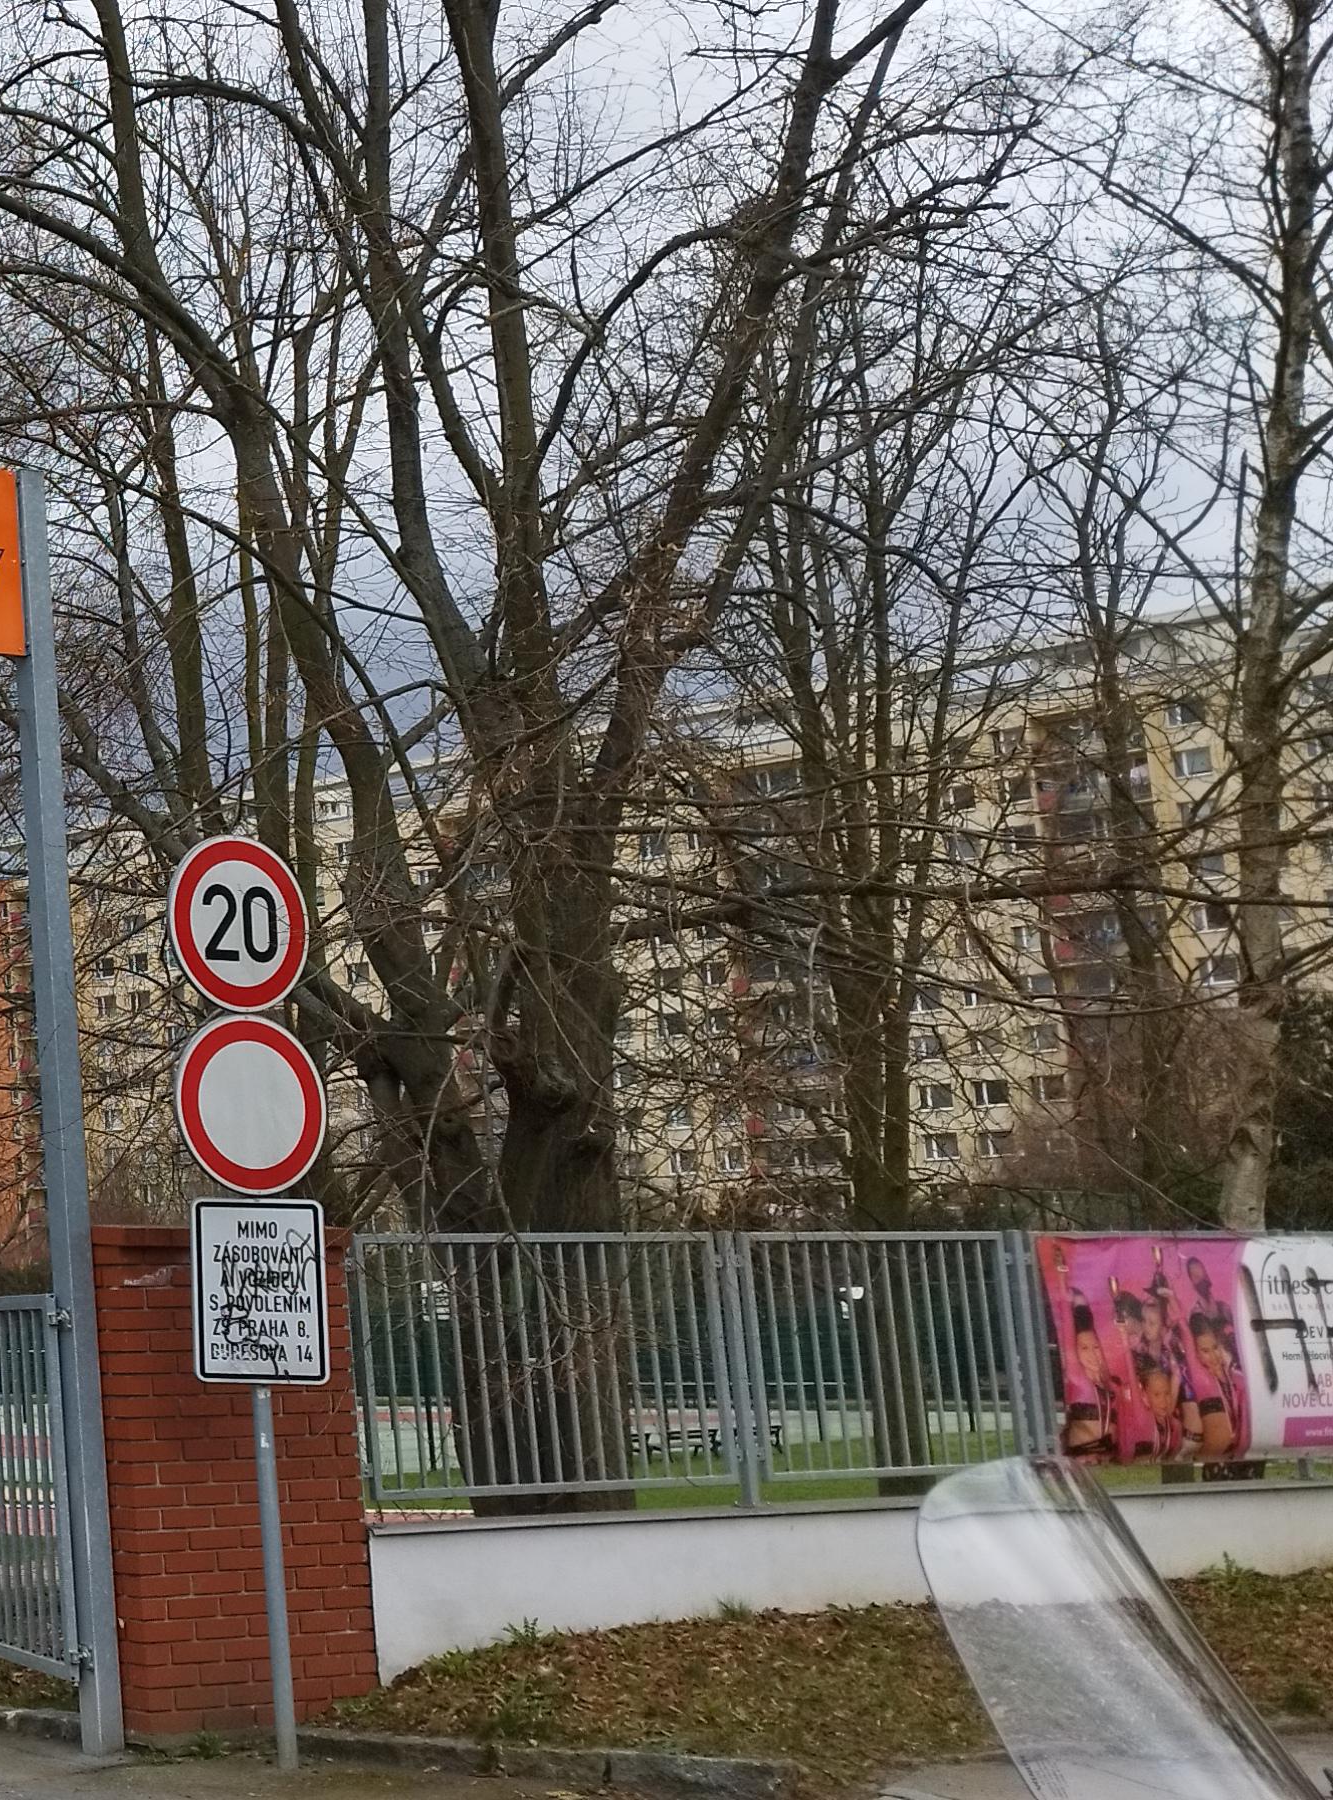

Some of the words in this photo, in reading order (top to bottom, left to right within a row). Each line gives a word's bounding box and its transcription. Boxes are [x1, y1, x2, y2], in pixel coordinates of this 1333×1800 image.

[202, 884, 278, 963] 20
[237, 1220, 278, 1240] MIMO
[209, 1294, 219, 1311] S
[238, 1319, 290, 1338] PRAHA
[296, 1345, 314, 1363] 14
